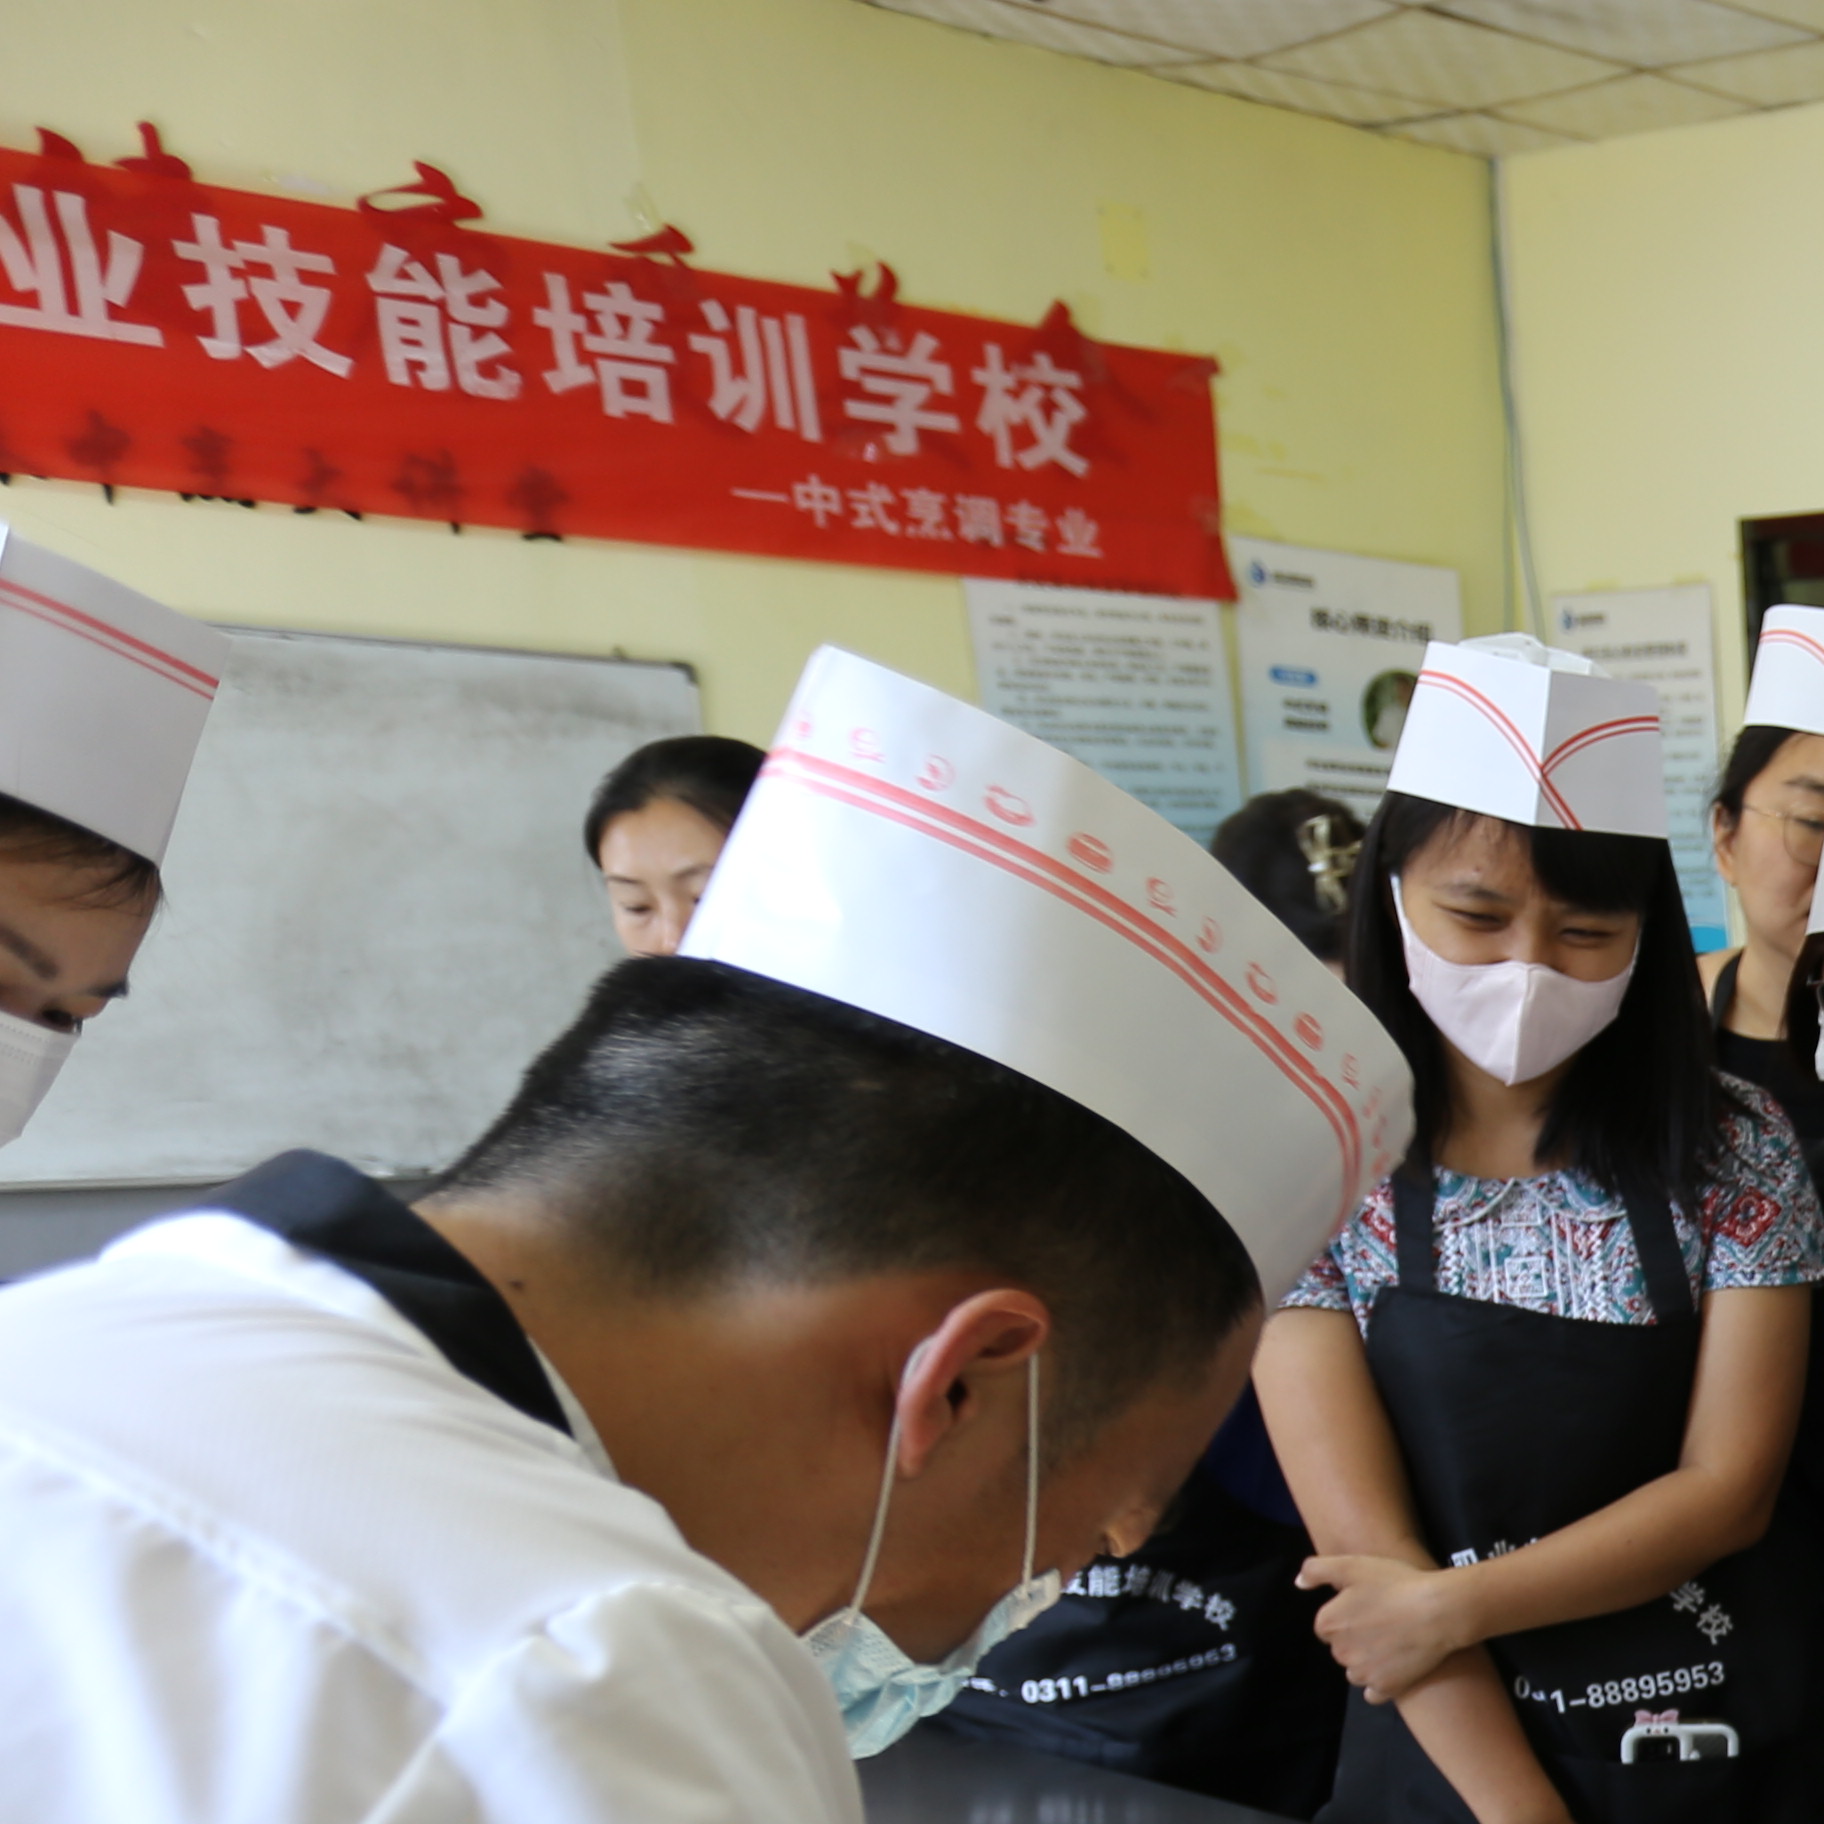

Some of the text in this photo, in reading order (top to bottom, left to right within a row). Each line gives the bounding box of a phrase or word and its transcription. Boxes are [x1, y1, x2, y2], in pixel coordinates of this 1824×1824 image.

[0, 183, 1091, 477] 业技能培训学校
